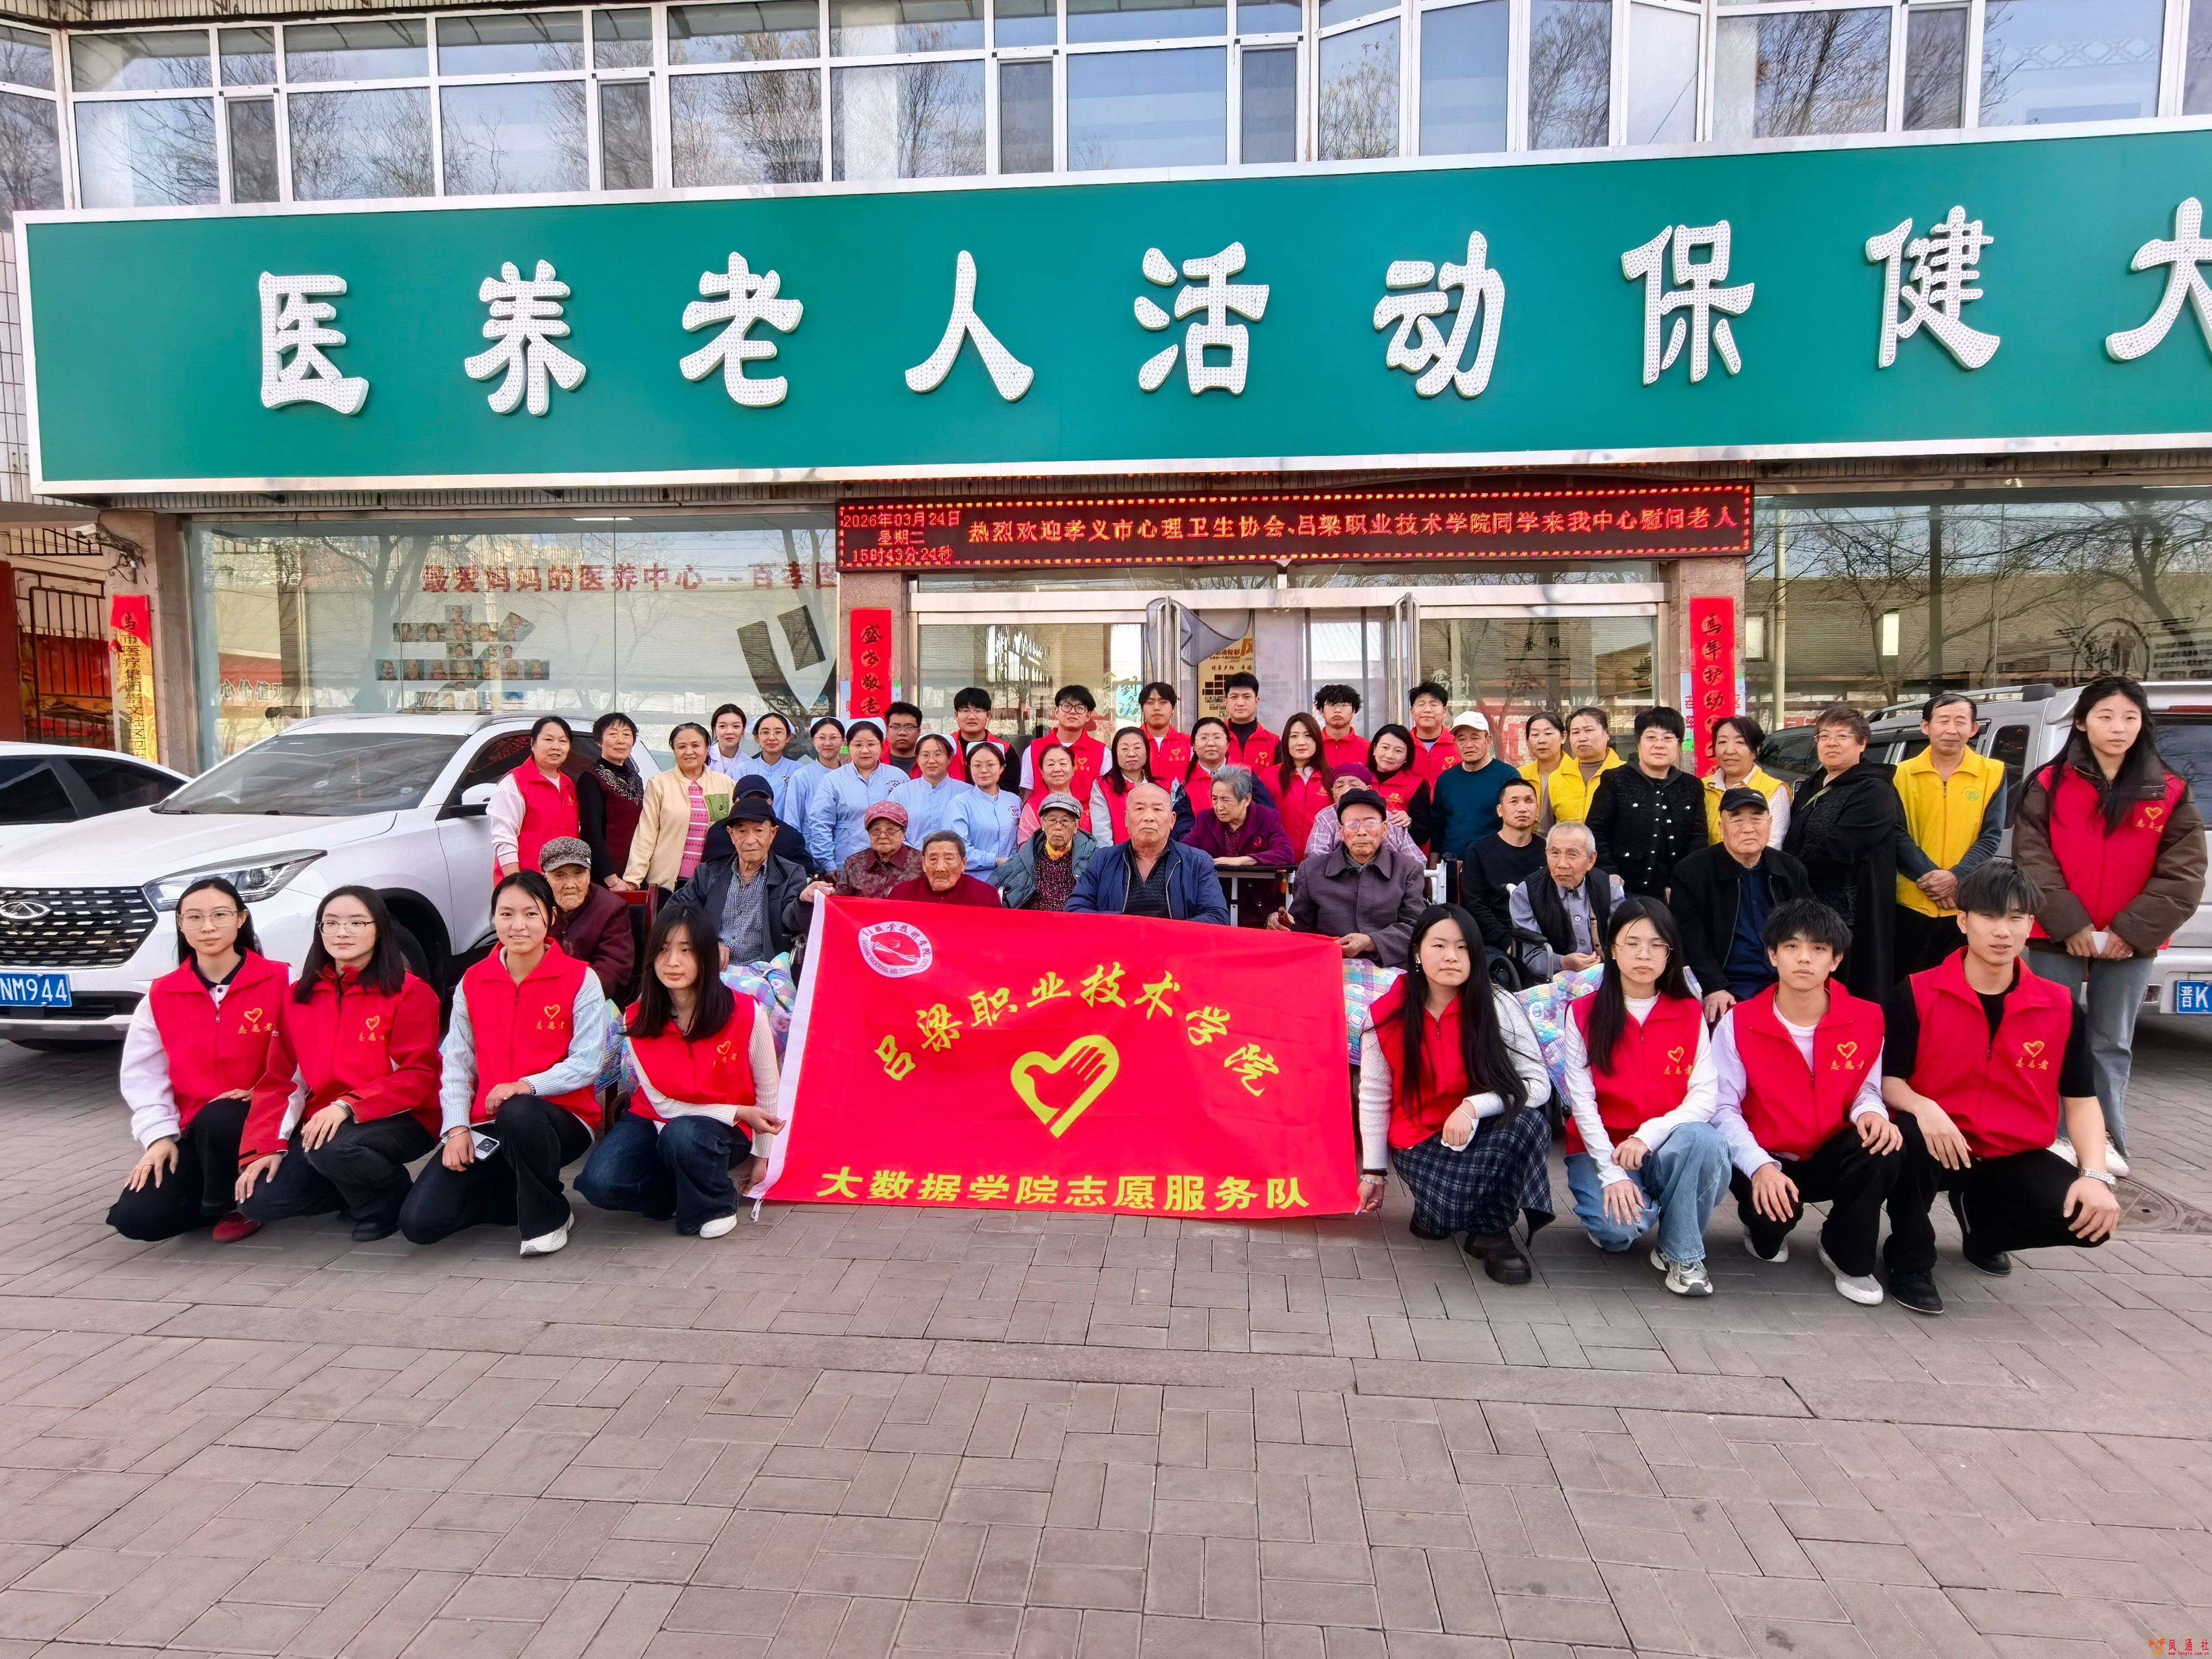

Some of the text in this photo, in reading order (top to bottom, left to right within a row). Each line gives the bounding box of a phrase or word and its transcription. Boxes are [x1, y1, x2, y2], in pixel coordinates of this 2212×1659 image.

[259, 197, 2212, 416] 医养老人活动保健大
[844, 510, 960, 528] 2026年03月24日
[878, 529, 925, 545] 星期二
[968, 505, 1737, 543] 热烈欢迎孝义市心理卫生协会、吕梁职业技术学院同学来我中心慰问老人
[1702, 613, 1724, 776] 马年护幼
[874, 961, 1279, 1097] 吕梁职业技术学院
[816, 1166, 1310, 1212] 大数据学院志愿服务队
